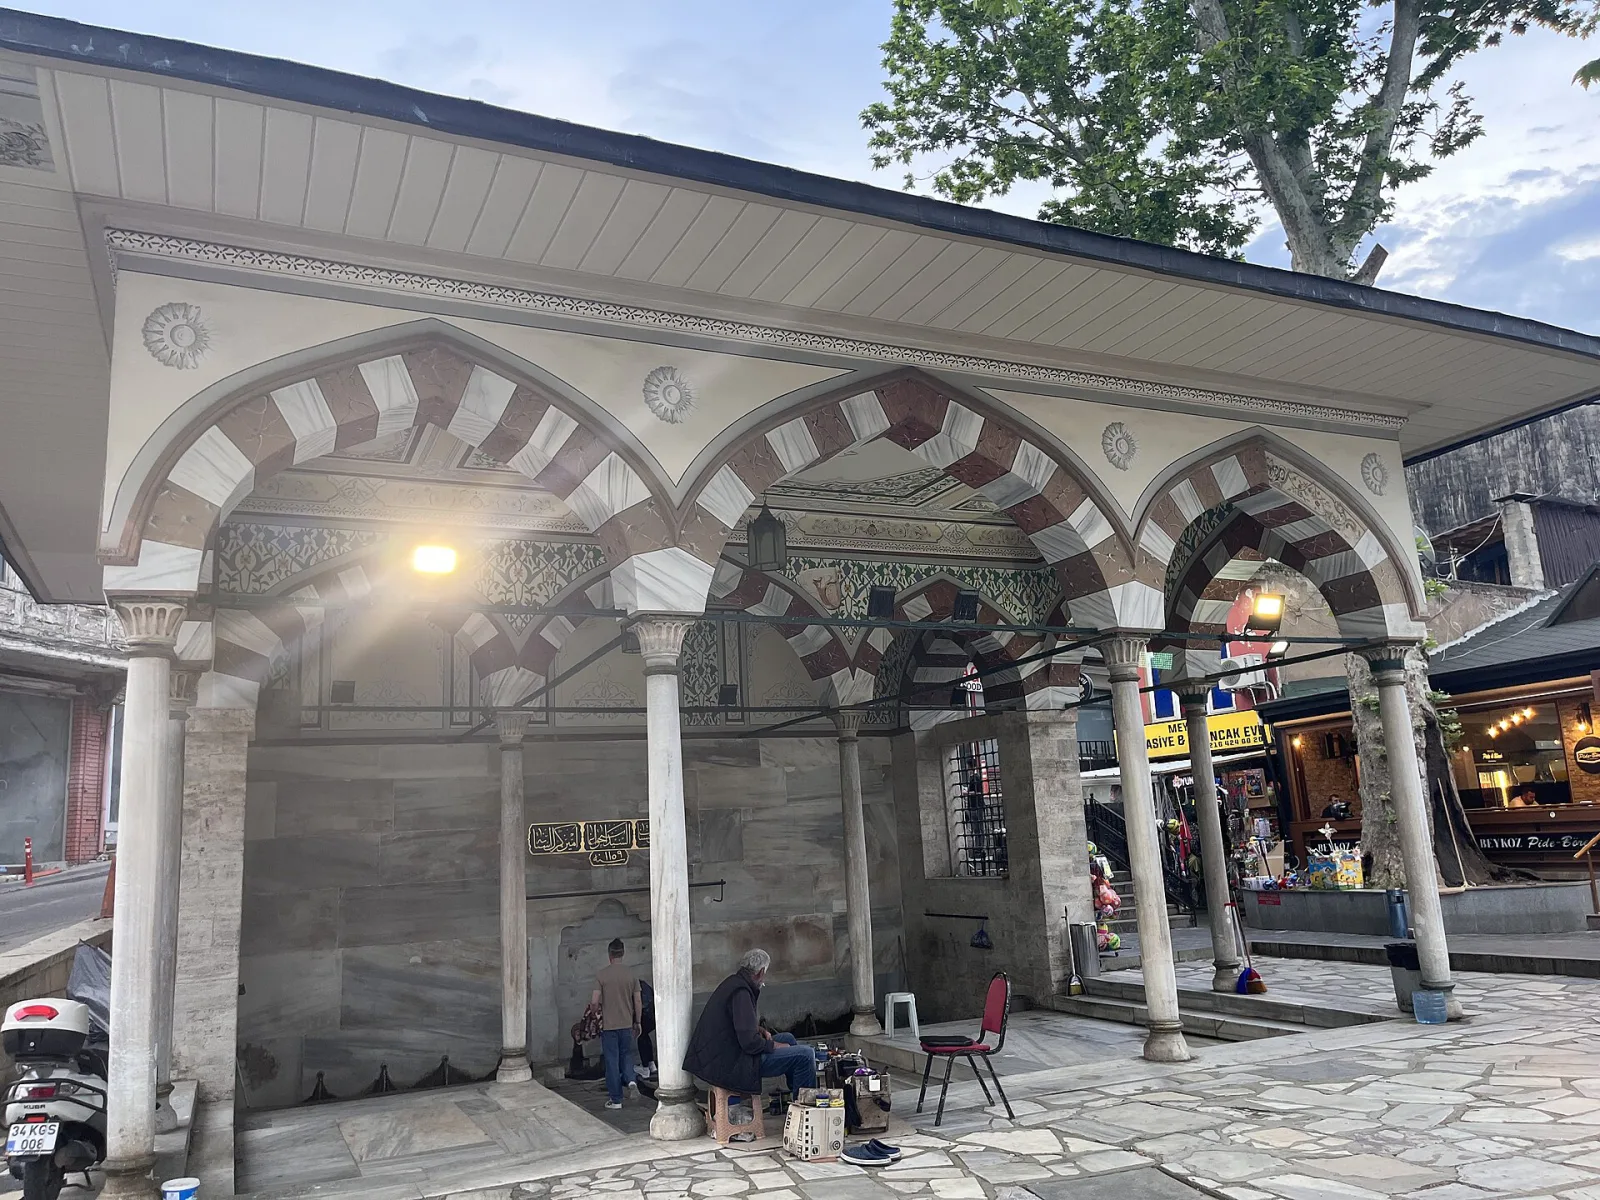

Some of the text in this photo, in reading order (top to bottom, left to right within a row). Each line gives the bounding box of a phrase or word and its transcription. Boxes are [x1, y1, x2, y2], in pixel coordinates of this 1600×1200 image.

[1168, 722, 1187, 733] MEY
[1146, 735, 1175, 749] ASİYE
[1177, 734, 1185, 746] &
[1210, 727, 1240, 742] NCAK
[1480, 838, 1522, 849] BEYKOZ
[785, 1111, 793, 1130] TOYS
[12, 1124, 57, 1137] 34 KGS
[21, 1138, 44, 1150] 008
